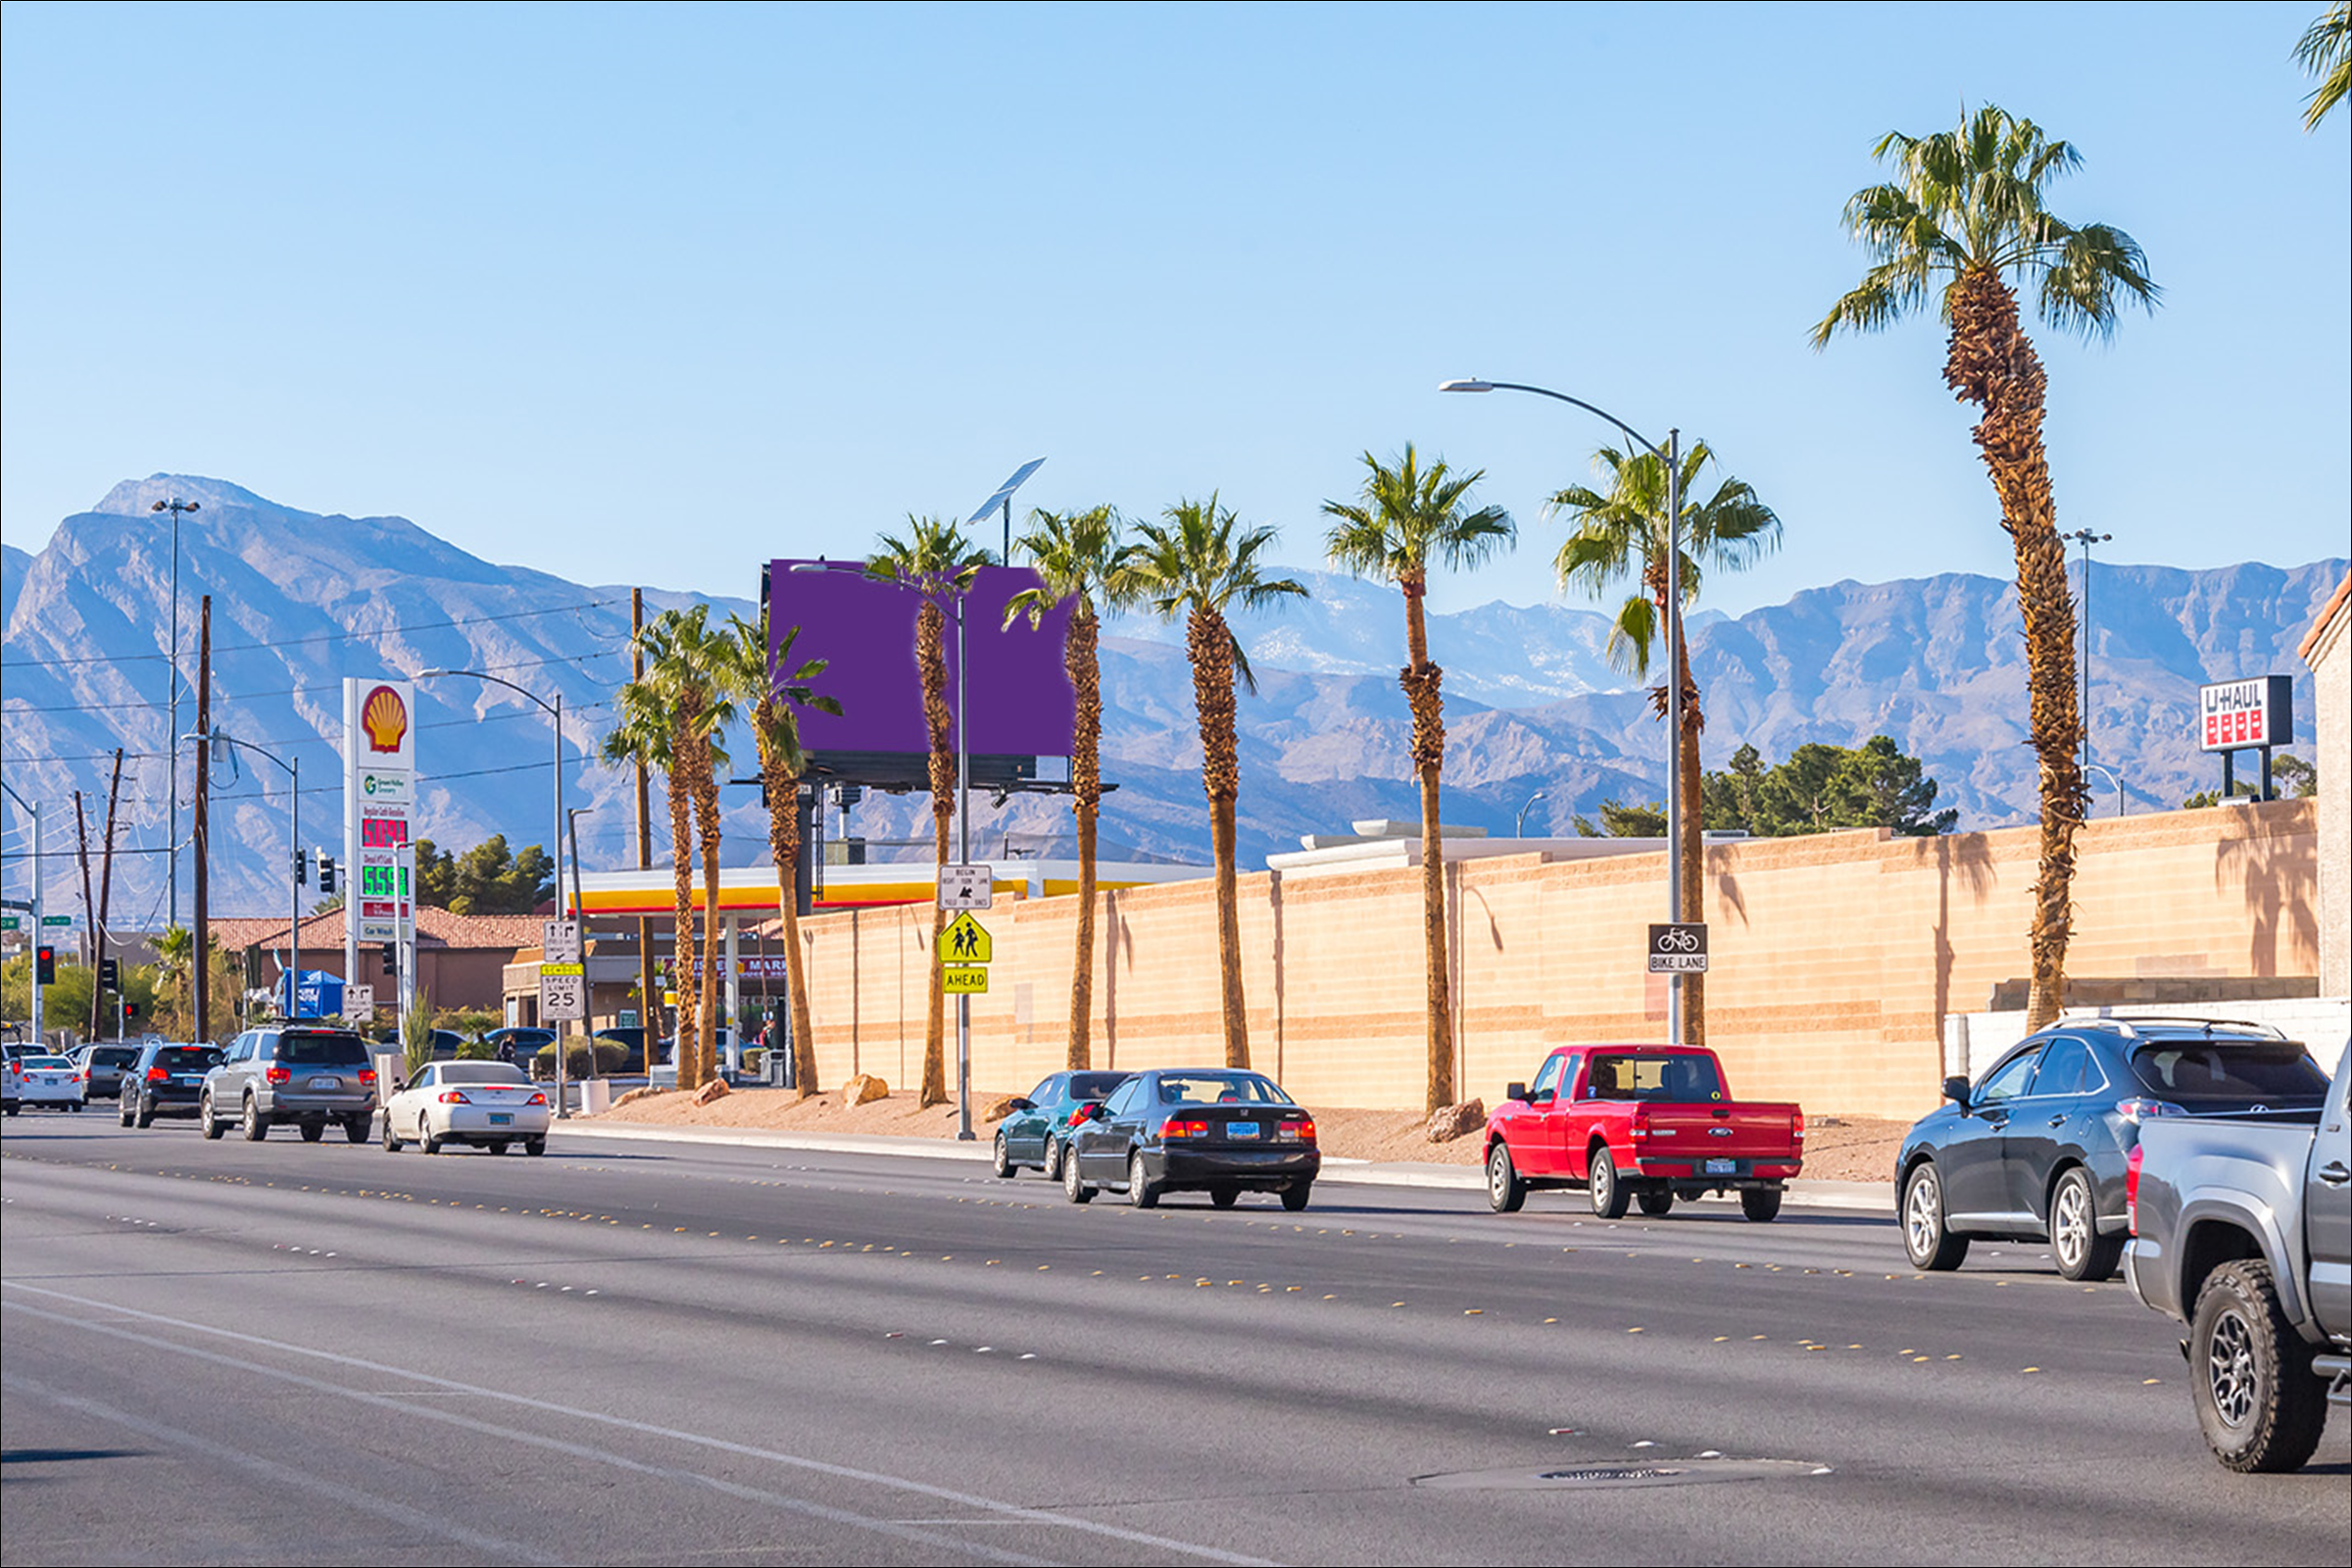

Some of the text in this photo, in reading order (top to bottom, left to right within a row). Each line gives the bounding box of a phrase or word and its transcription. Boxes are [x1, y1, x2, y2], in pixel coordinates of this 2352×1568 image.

[2206, 683, 2262, 712] U-HAUL
[1651, 956, 1704, 968] BIKE LANE
[947, 974, 984, 986] AHEAD
[548, 992, 575, 1006] 25
